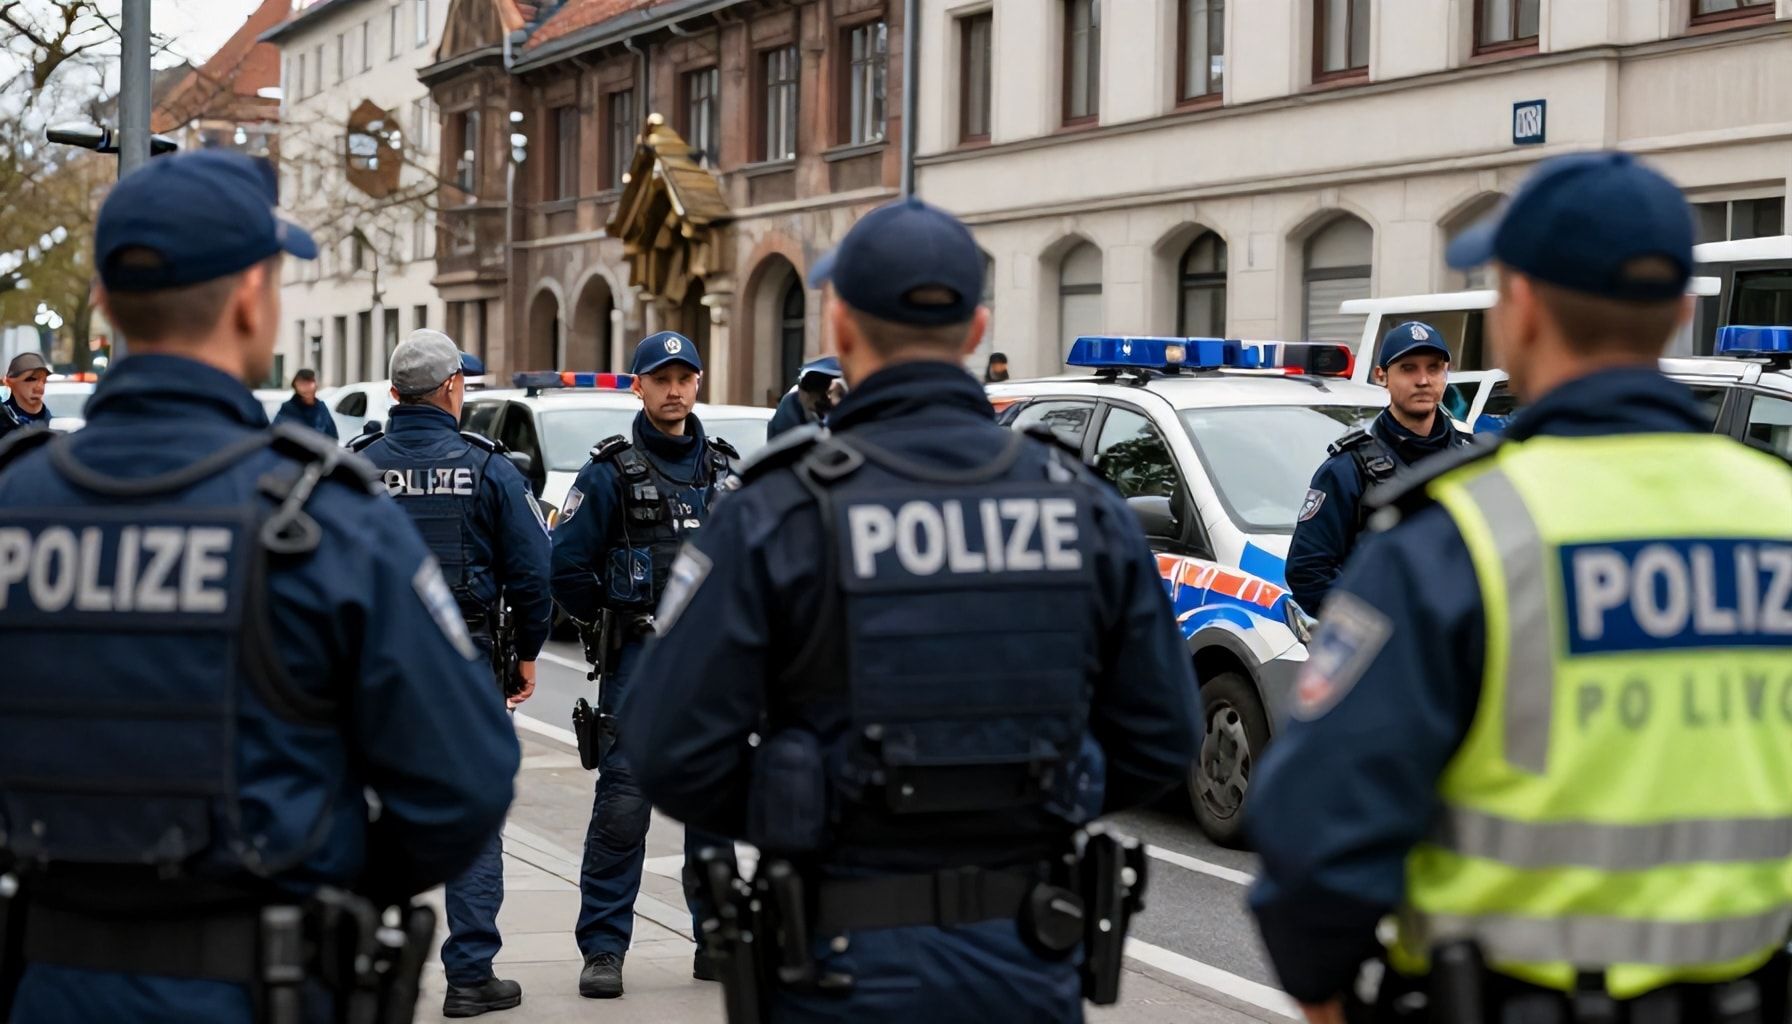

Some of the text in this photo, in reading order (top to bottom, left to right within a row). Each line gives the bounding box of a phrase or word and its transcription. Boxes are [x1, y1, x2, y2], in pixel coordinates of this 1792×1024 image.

[0, 526, 232, 613] POLIZE
[848, 498, 1082, 579] POLIZE
[1572, 543, 1792, 641] POLIZ
